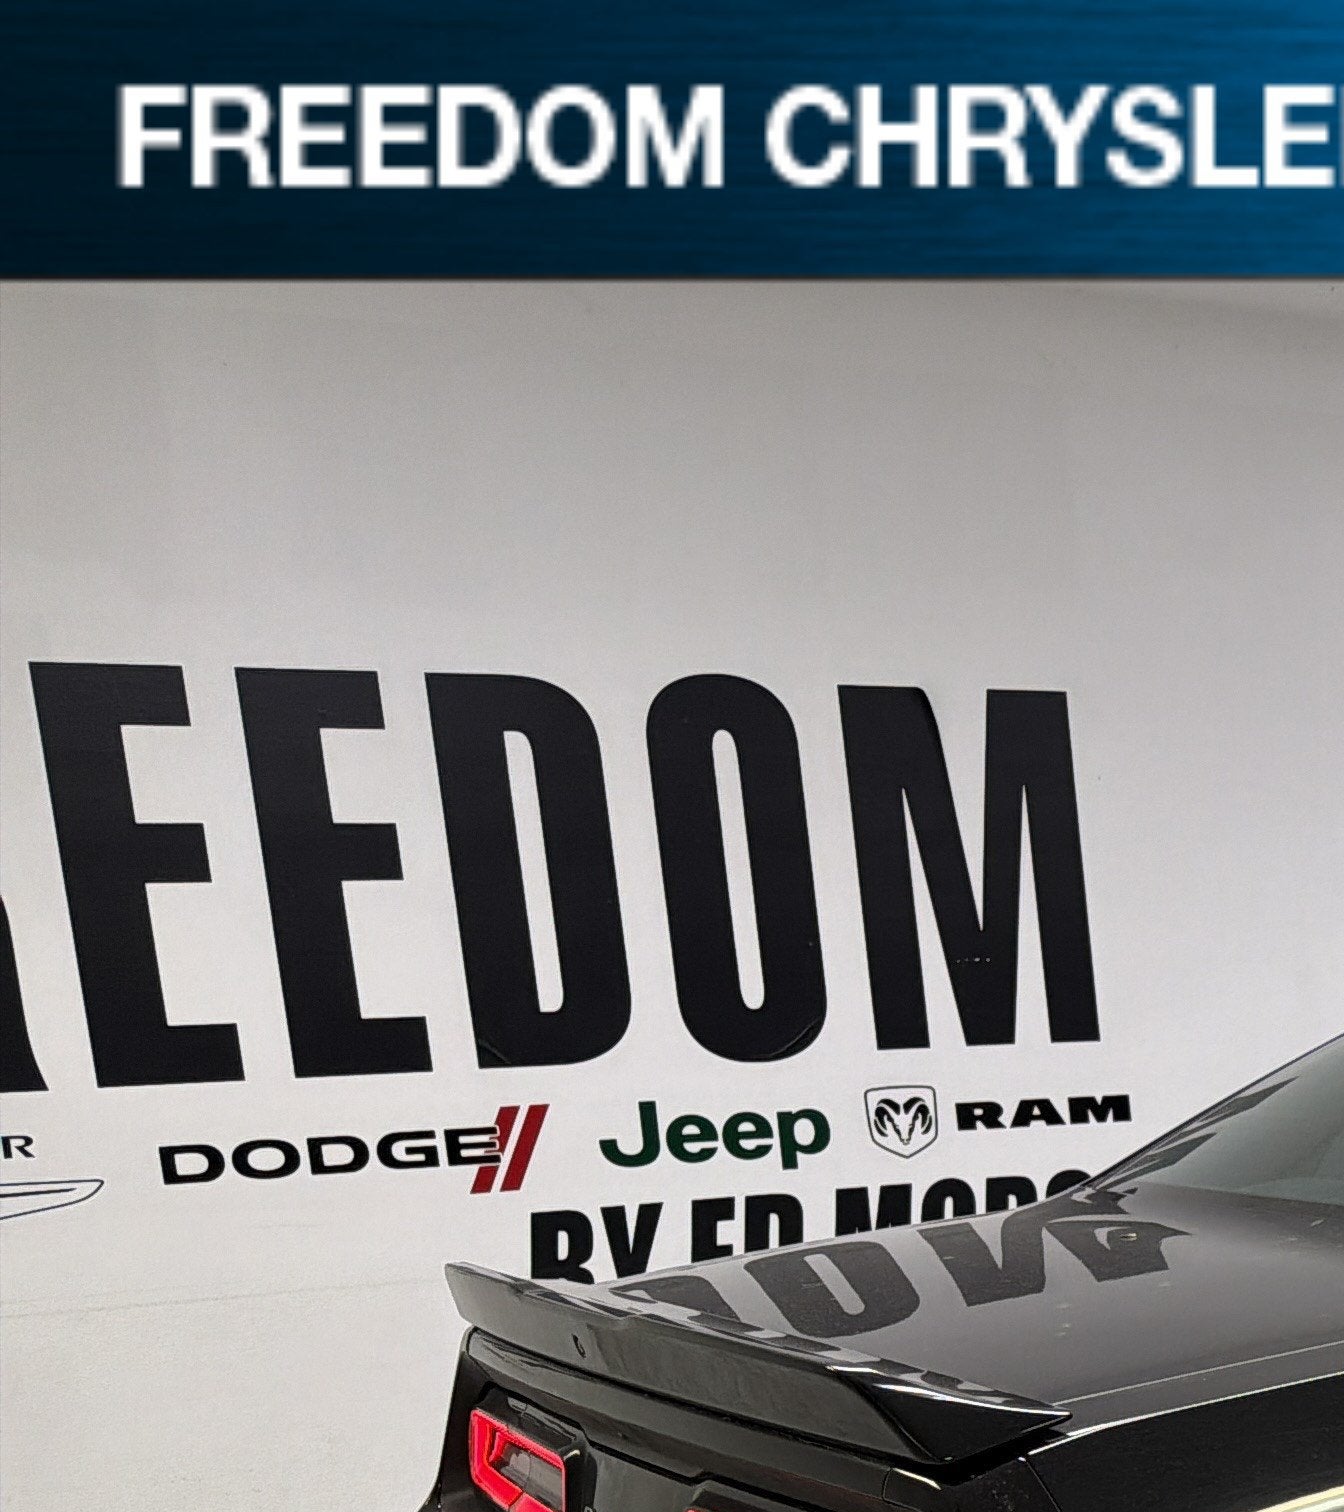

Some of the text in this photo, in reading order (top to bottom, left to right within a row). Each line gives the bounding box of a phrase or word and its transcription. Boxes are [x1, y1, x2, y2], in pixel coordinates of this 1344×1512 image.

[0, 661, 1101, 1094] EEDOM
[598, 1100, 831, 1171] Jeep
[954, 1094, 1132, 1131] RAM
[158, 1126, 502, 1186] DODGE
